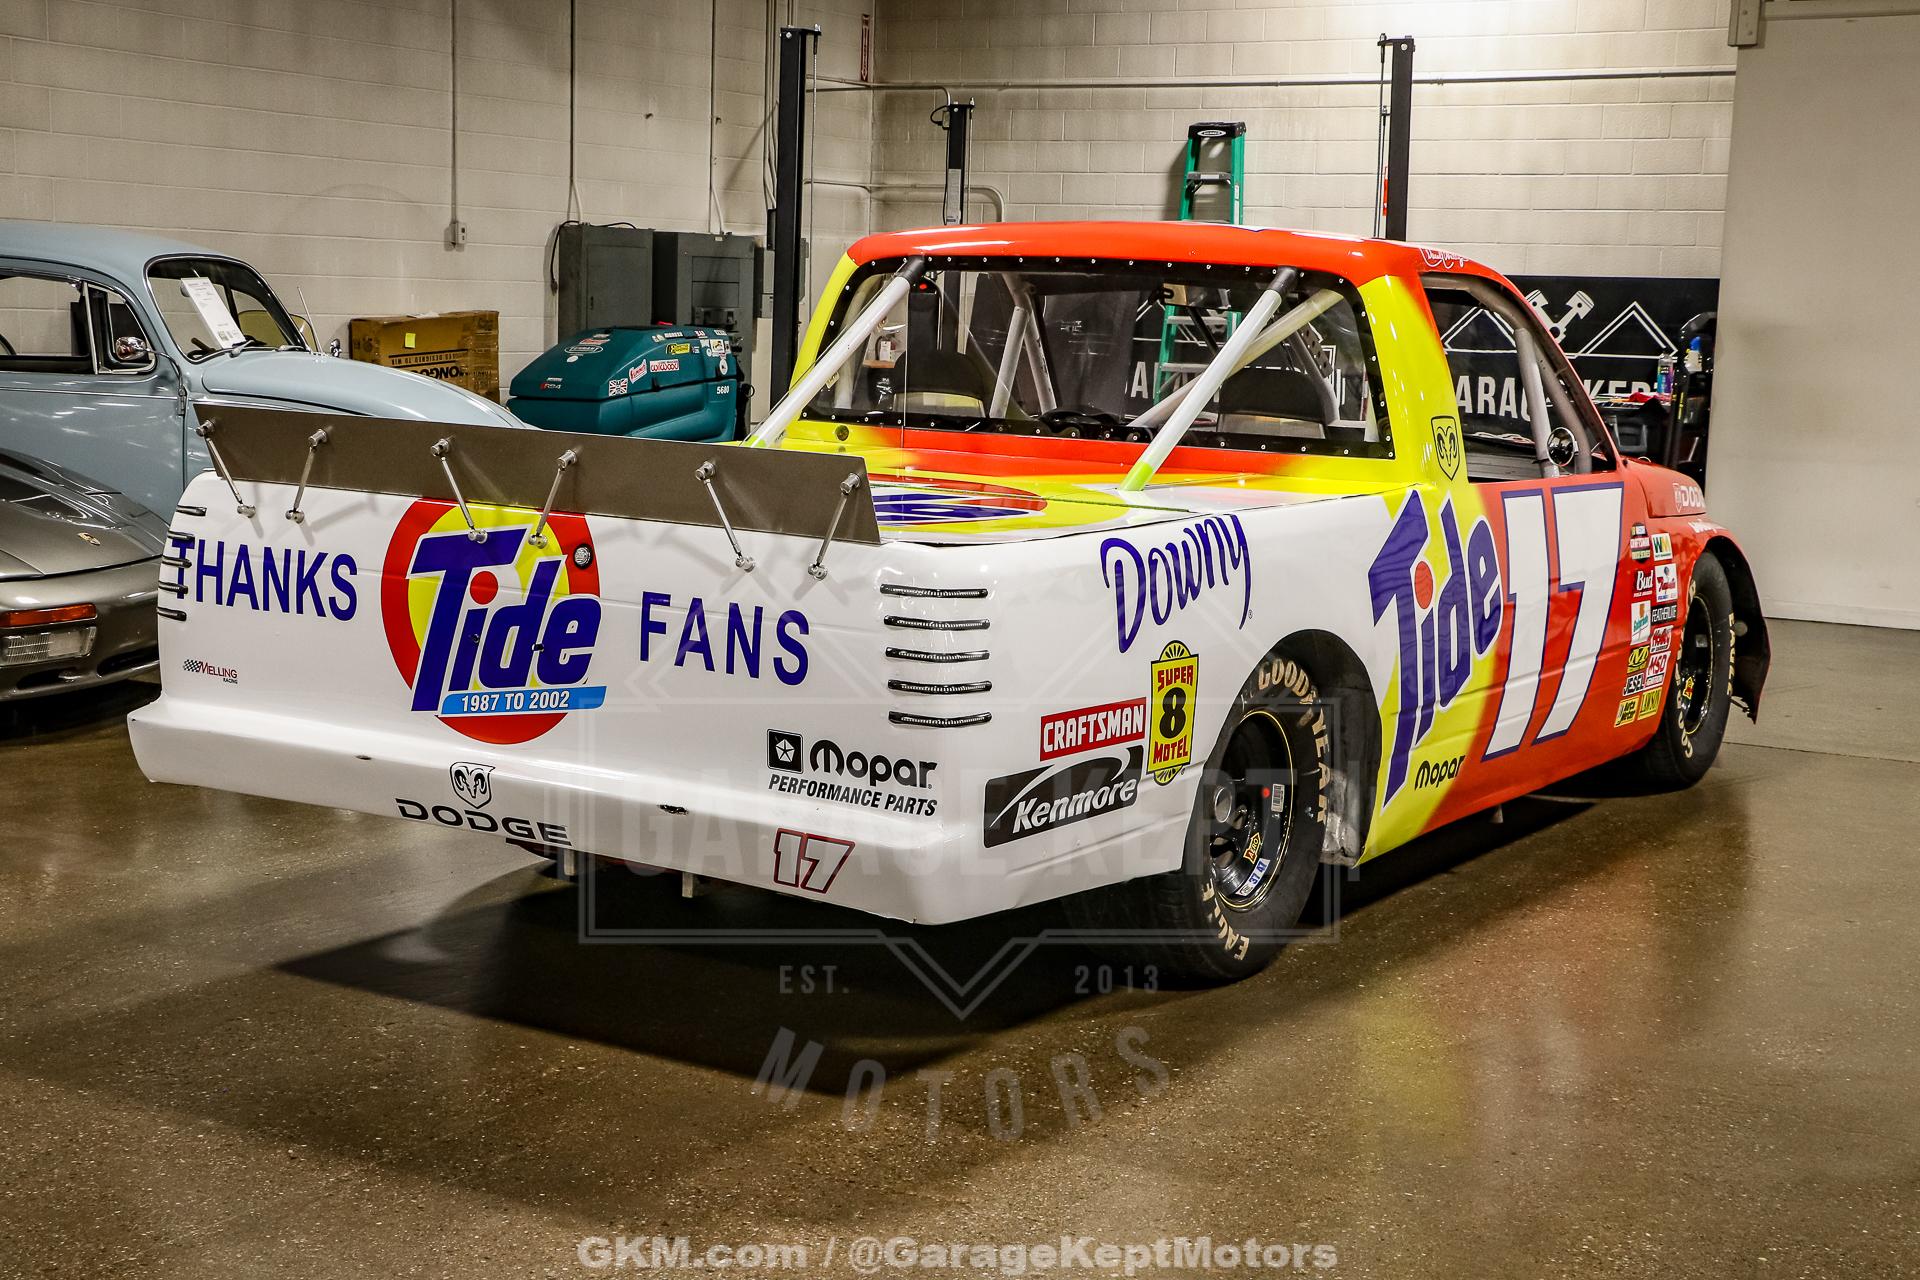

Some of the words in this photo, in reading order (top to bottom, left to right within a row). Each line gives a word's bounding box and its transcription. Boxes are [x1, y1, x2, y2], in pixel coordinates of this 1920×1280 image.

[171, 536, 358, 622] THANKS
[1100, 514, 1250, 654] Downy
[408, 523, 602, 711] Tide
[640, 591, 810, 686] FANS
[1482, 482, 1625, 762] 17
[1157, 664, 1194, 690] SUPER
[1368, 489, 1502, 809] Tide
[461, 694, 499, 712] 1987
[505, 693, 524, 710] TO
[530, 691, 570, 709] 2002
[1042, 703, 1145, 754] CRAFTSMAN
[1159, 687, 1187, 740] 8
[1152, 741, 1188, 764] MOTEL
[395, 798, 572, 847] DODGE
[768, 773, 882, 810] PERFORMANCE
[885, 791, 938, 817] PARTS
[1011, 774, 1138, 834] Kenmore
[773, 827, 855, 894] 17
